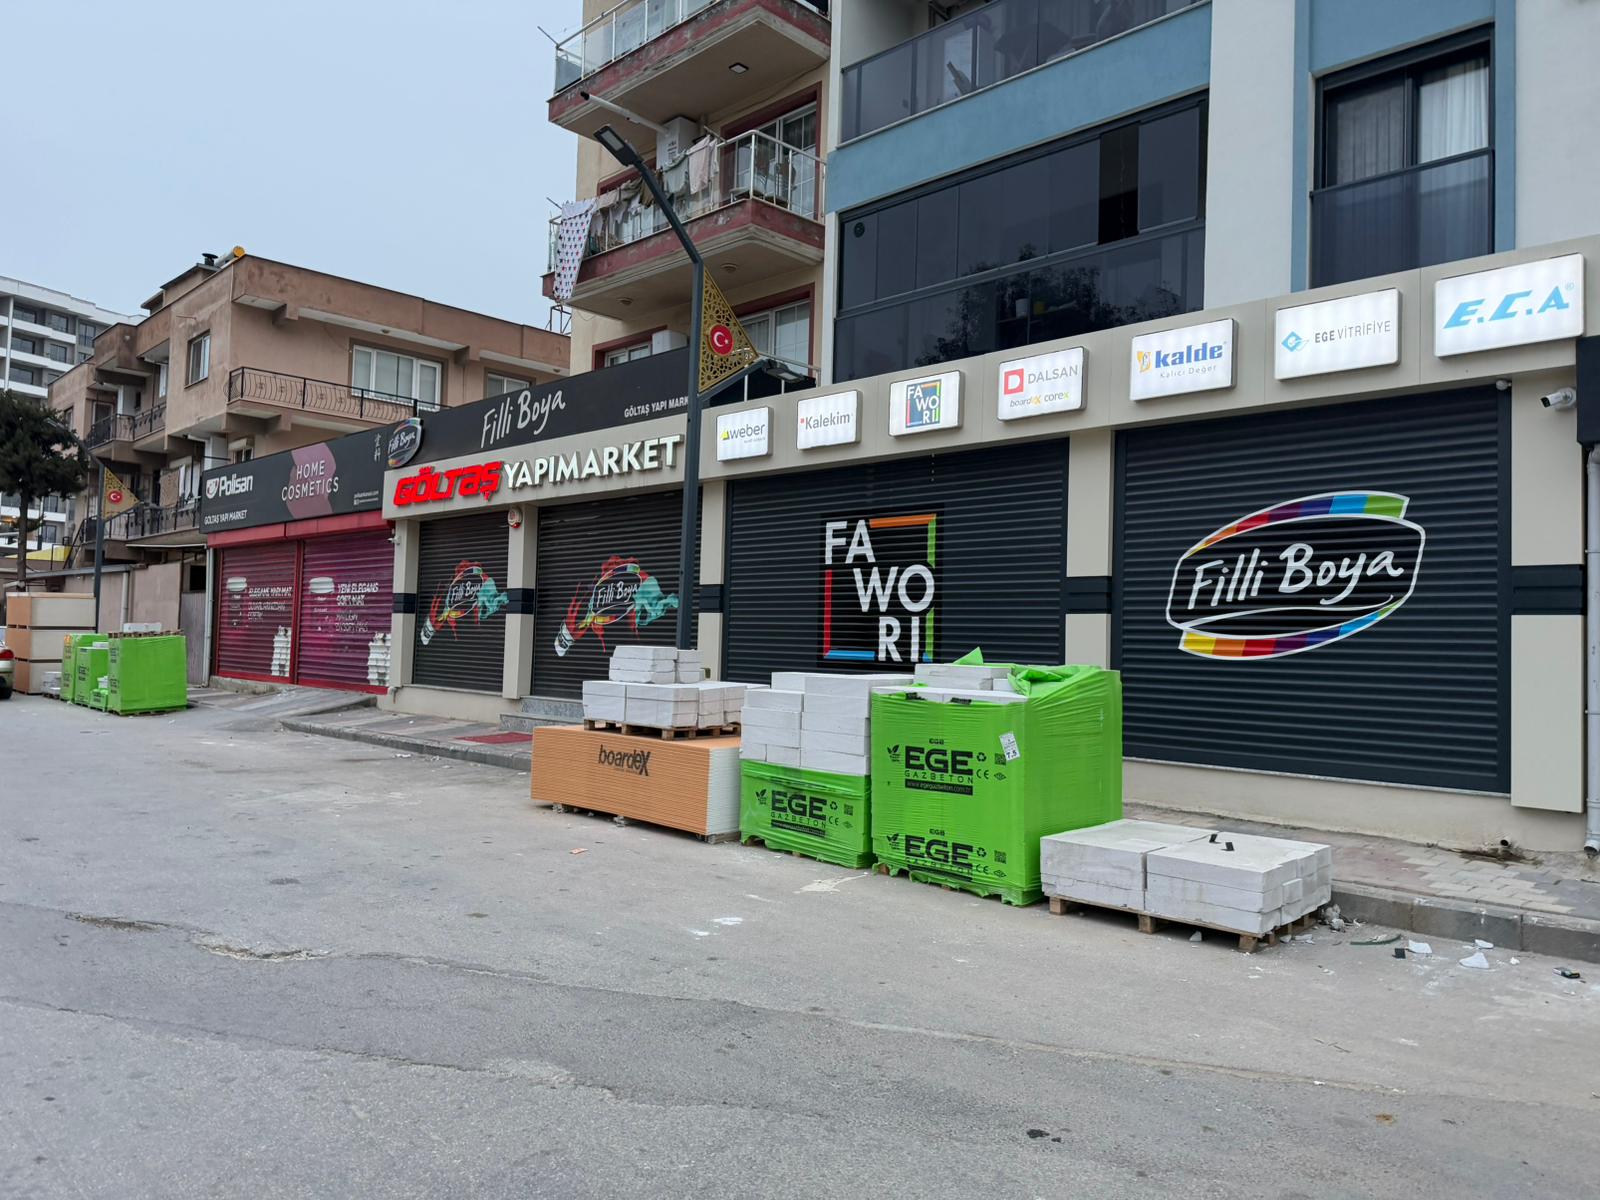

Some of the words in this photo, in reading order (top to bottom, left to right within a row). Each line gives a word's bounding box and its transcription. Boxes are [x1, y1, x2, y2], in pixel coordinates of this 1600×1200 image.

[1443, 285, 1569, 329] E.C.A
[1315, 330, 1335, 343] EGE
[1337, 320, 1391, 340] VİTRİFİYE
[1155, 342, 1223, 369] kalde
[1028, 364, 1078, 384] DALSAN
[481, 395, 513, 449] Filli
[517, 389, 566, 436] Boya
[624, 404, 650, 418] GÖLTAŞ
[651, 400, 667, 412] YAPI
[668, 396, 689, 409] MARK
[729, 424, 765, 440] weber
[805, 411, 850, 430] Kalekim
[296, 459, 326, 480] HOME
[219, 473, 253, 497] Polisan
[281, 476, 339, 501] COSMETICS
[825, 519, 876, 565] FA
[853, 564, 935, 613] WO
[1187, 548, 1269, 610] Filli
[1278, 543, 1404, 605] Boya
[877, 615, 920, 663] RI
[905, 745, 974, 776] EGE
[904, 769, 974, 784] GAZBETON
[771, 790, 828, 821] EGE
[770, 811, 826, 829] GAZBETON
[905, 834, 974, 869] EGE
